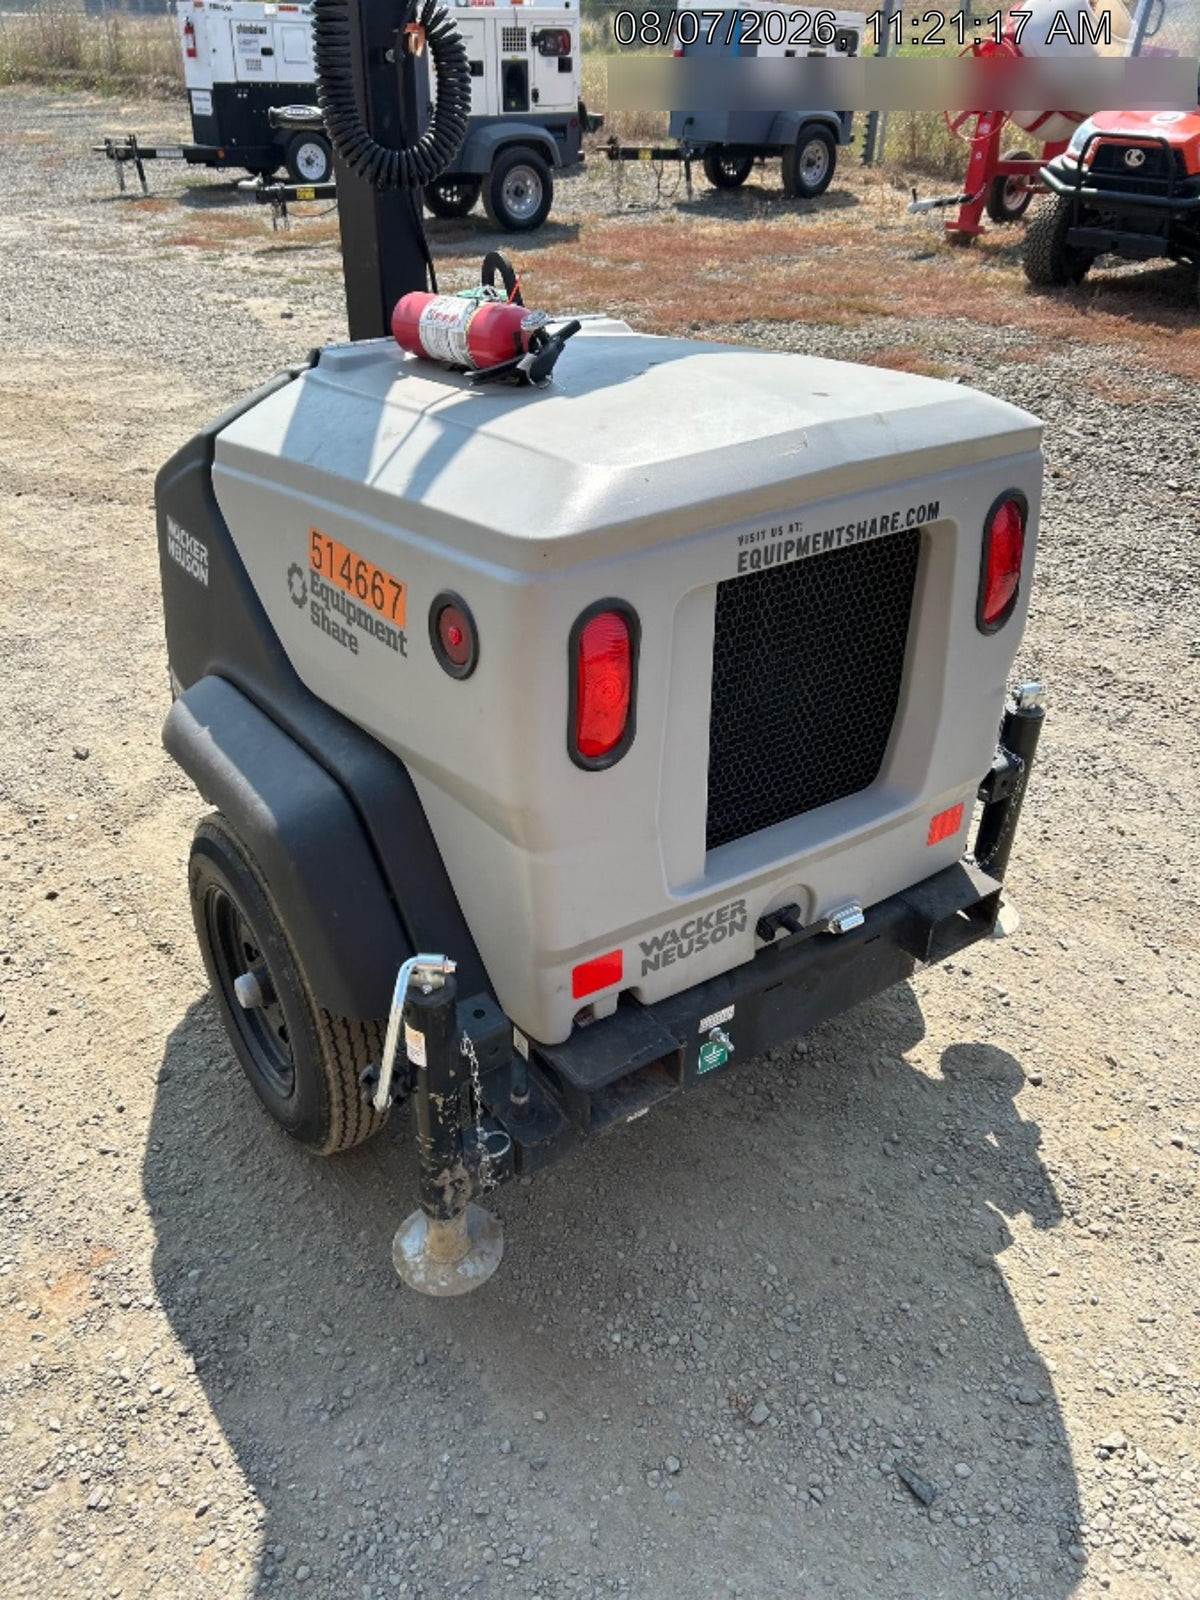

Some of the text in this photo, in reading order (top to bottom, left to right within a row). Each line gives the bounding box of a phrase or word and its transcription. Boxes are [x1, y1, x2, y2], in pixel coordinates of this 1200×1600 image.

[737, 529, 766, 547] VISIT
[771, 524, 783, 538] US
[737, 501, 940, 573] EQUIPMENTSHARE.COM
[310, 530, 403, 620] 514667
[309, 568, 408, 658] Equipment
[310, 604, 359, 655] Share
[638, 899, 748, 957] WACKER
[641, 915, 748, 977] NEUSON
